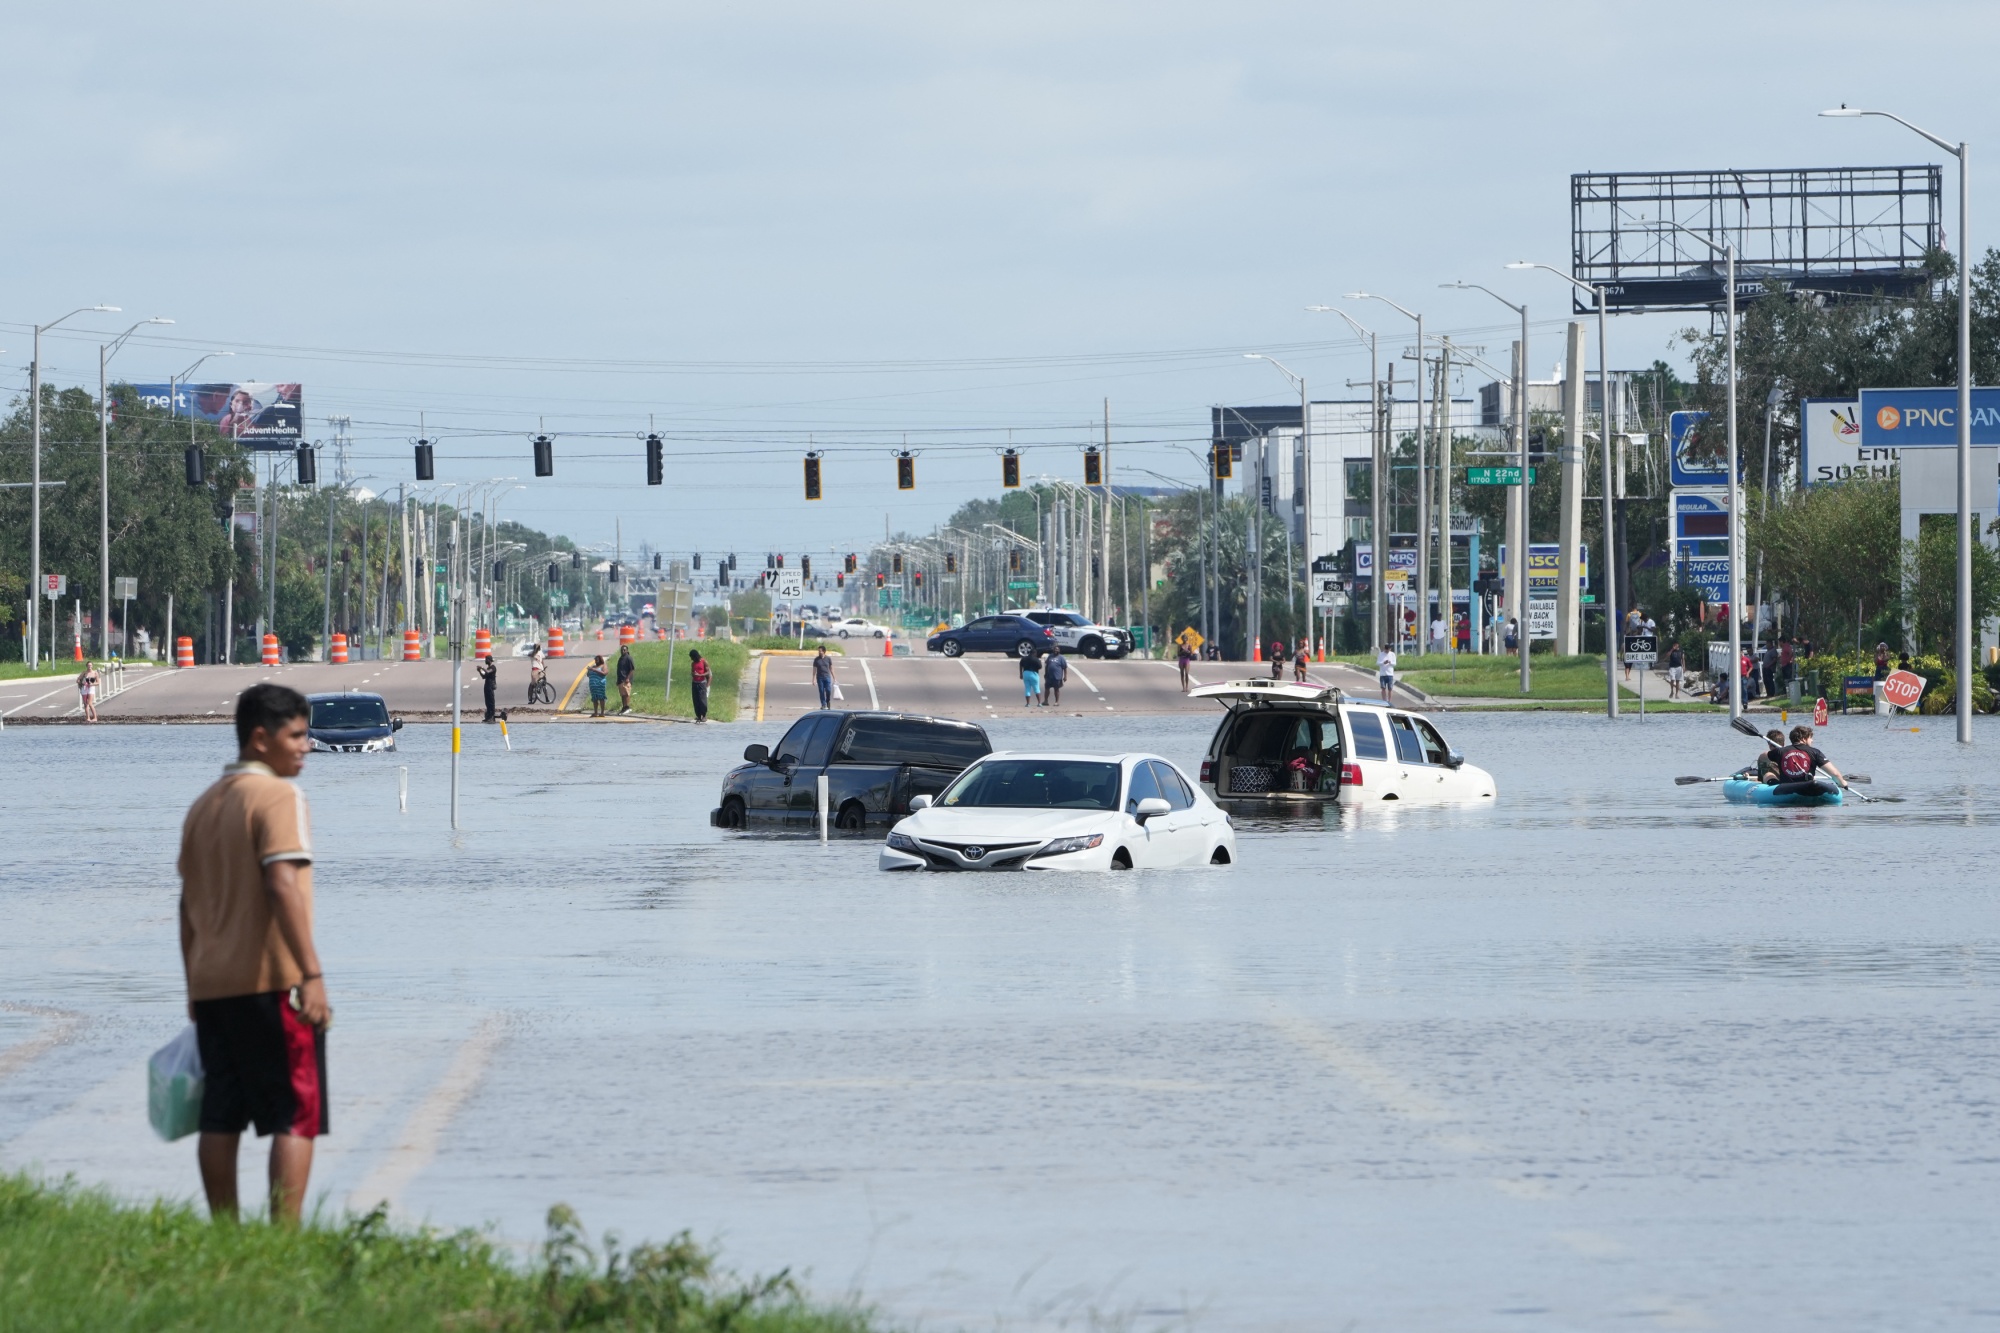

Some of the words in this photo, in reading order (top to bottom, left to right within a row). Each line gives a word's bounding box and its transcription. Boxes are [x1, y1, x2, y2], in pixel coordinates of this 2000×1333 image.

[1904, 408, 1955, 427] PNC
[1957, 408, 2000, 427] AN
[1483, 469, 1490, 477] N
[1495, 469, 1520, 477] 22nd
[1360, 553, 1416, 567] CMPS
[1319, 561, 1338, 571] THE
[1689, 561, 1730, 572] CHECKS
[1535, 578, 1546, 586] 24
[1689, 574, 1730, 584] CASHED
[781, 586, 801, 597] 45
[1533, 611, 1550, 619] BACK
[1886, 678, 1919, 698] STOP
[1815, 708, 1827, 724] STOP
